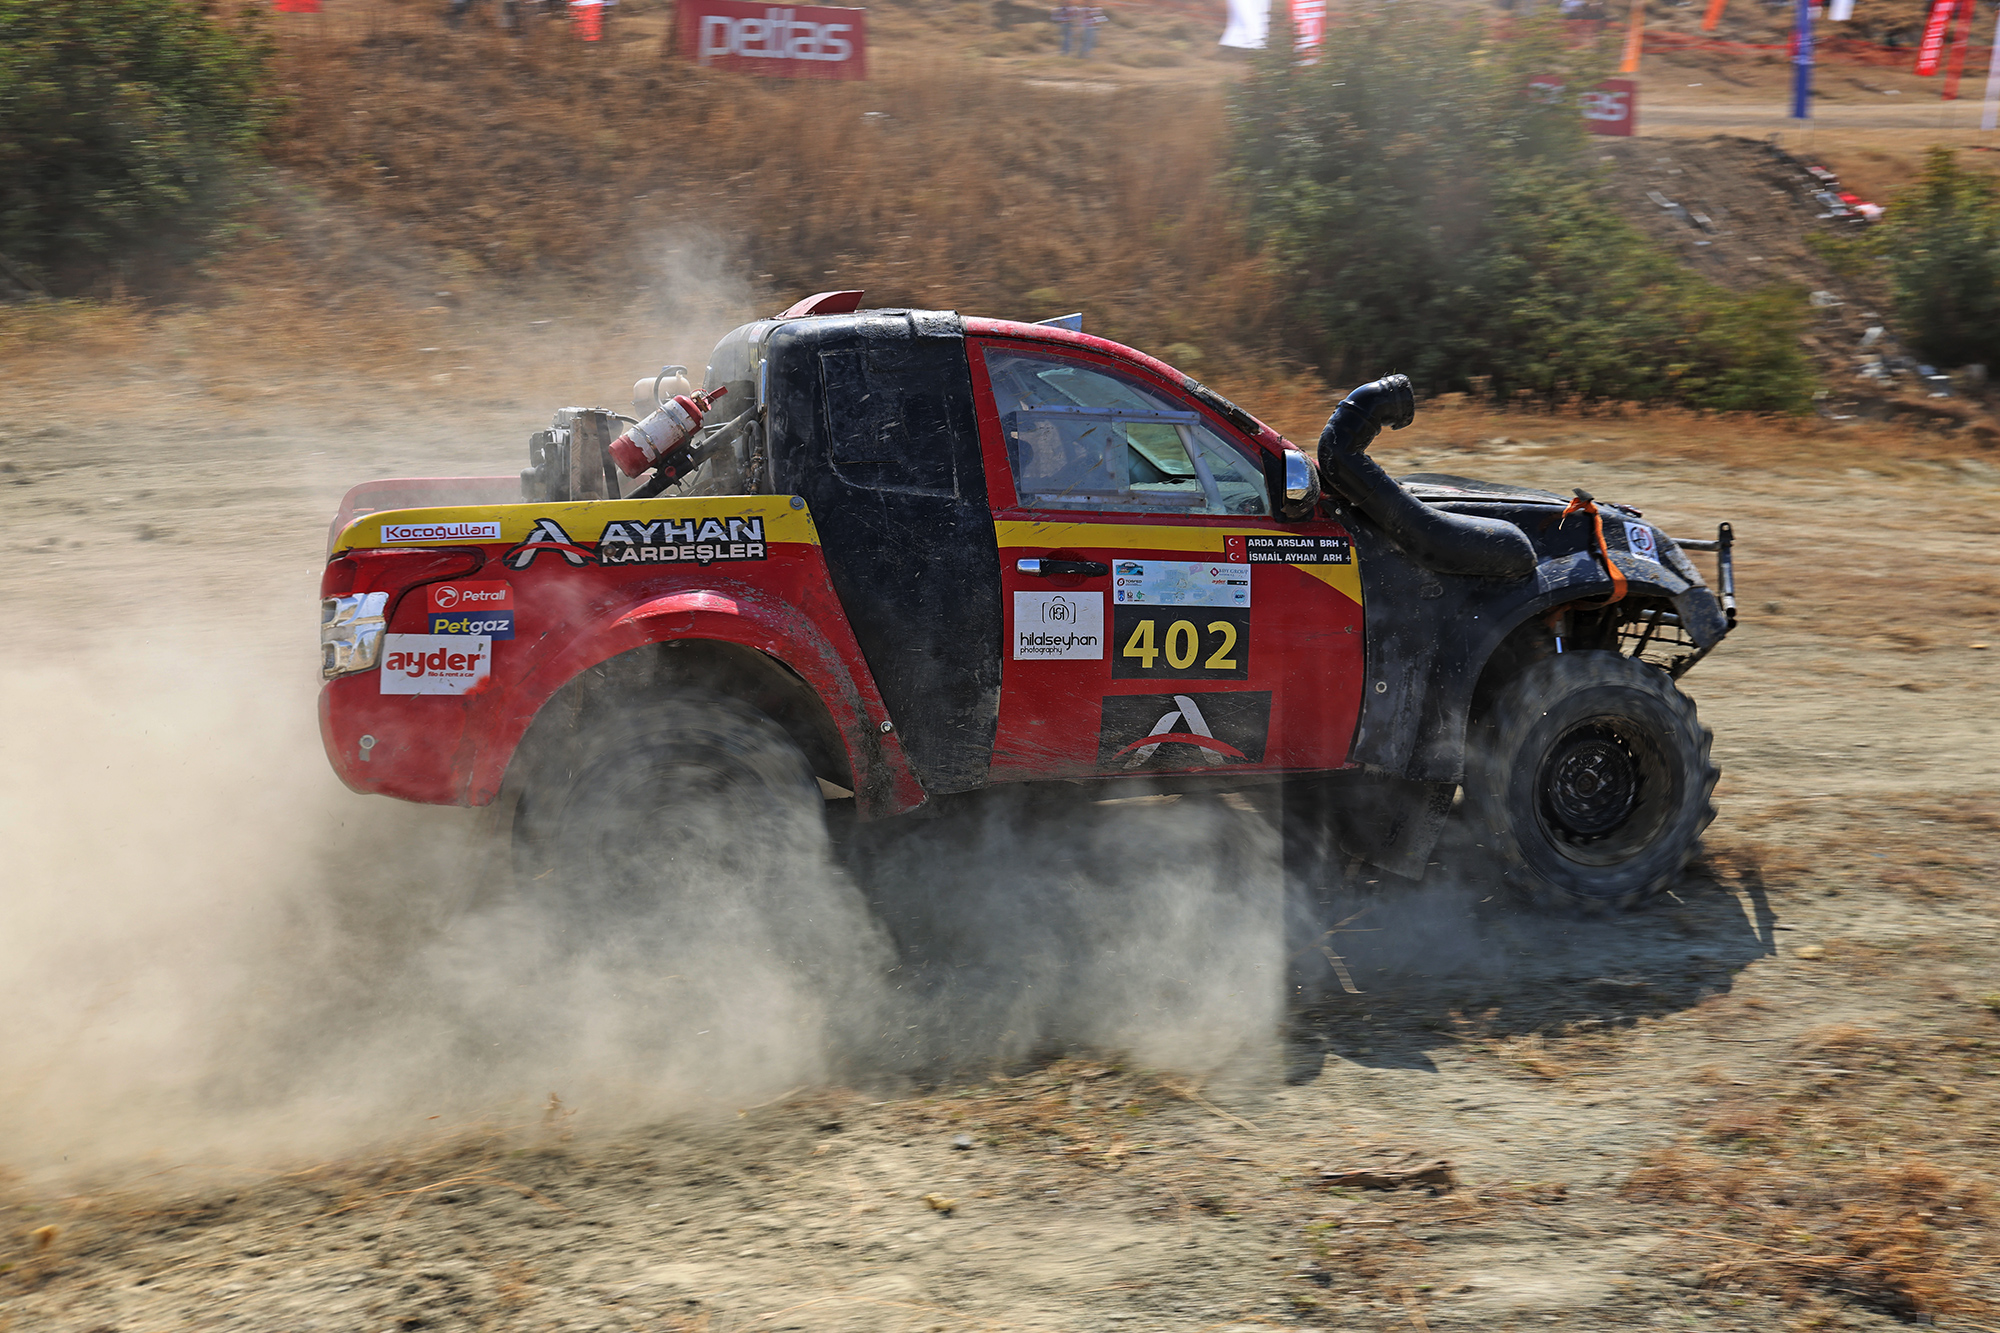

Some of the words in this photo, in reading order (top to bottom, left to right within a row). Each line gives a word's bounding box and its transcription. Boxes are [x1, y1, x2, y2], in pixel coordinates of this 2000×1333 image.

[600, 519, 762, 546] AYHAN
[1248, 539, 1274, 547] ARDA
[1277, 539, 1314, 547] ARSLAN
[1320, 539, 1339, 547] BRH
[602, 543, 764, 563] KARDEŞLER
[1249, 551, 1282, 561] İSMAİL
[1285, 553, 1317, 561] AYHAN
[1323, 553, 1342, 562] ARH
[434, 618, 509, 636] Petgaz
[1020, 632, 1097, 651] hilalseyhan
[1020, 646, 1062, 656] photography
[1123, 620, 1237, 669] 402
[386, 648, 481, 678] ayder
